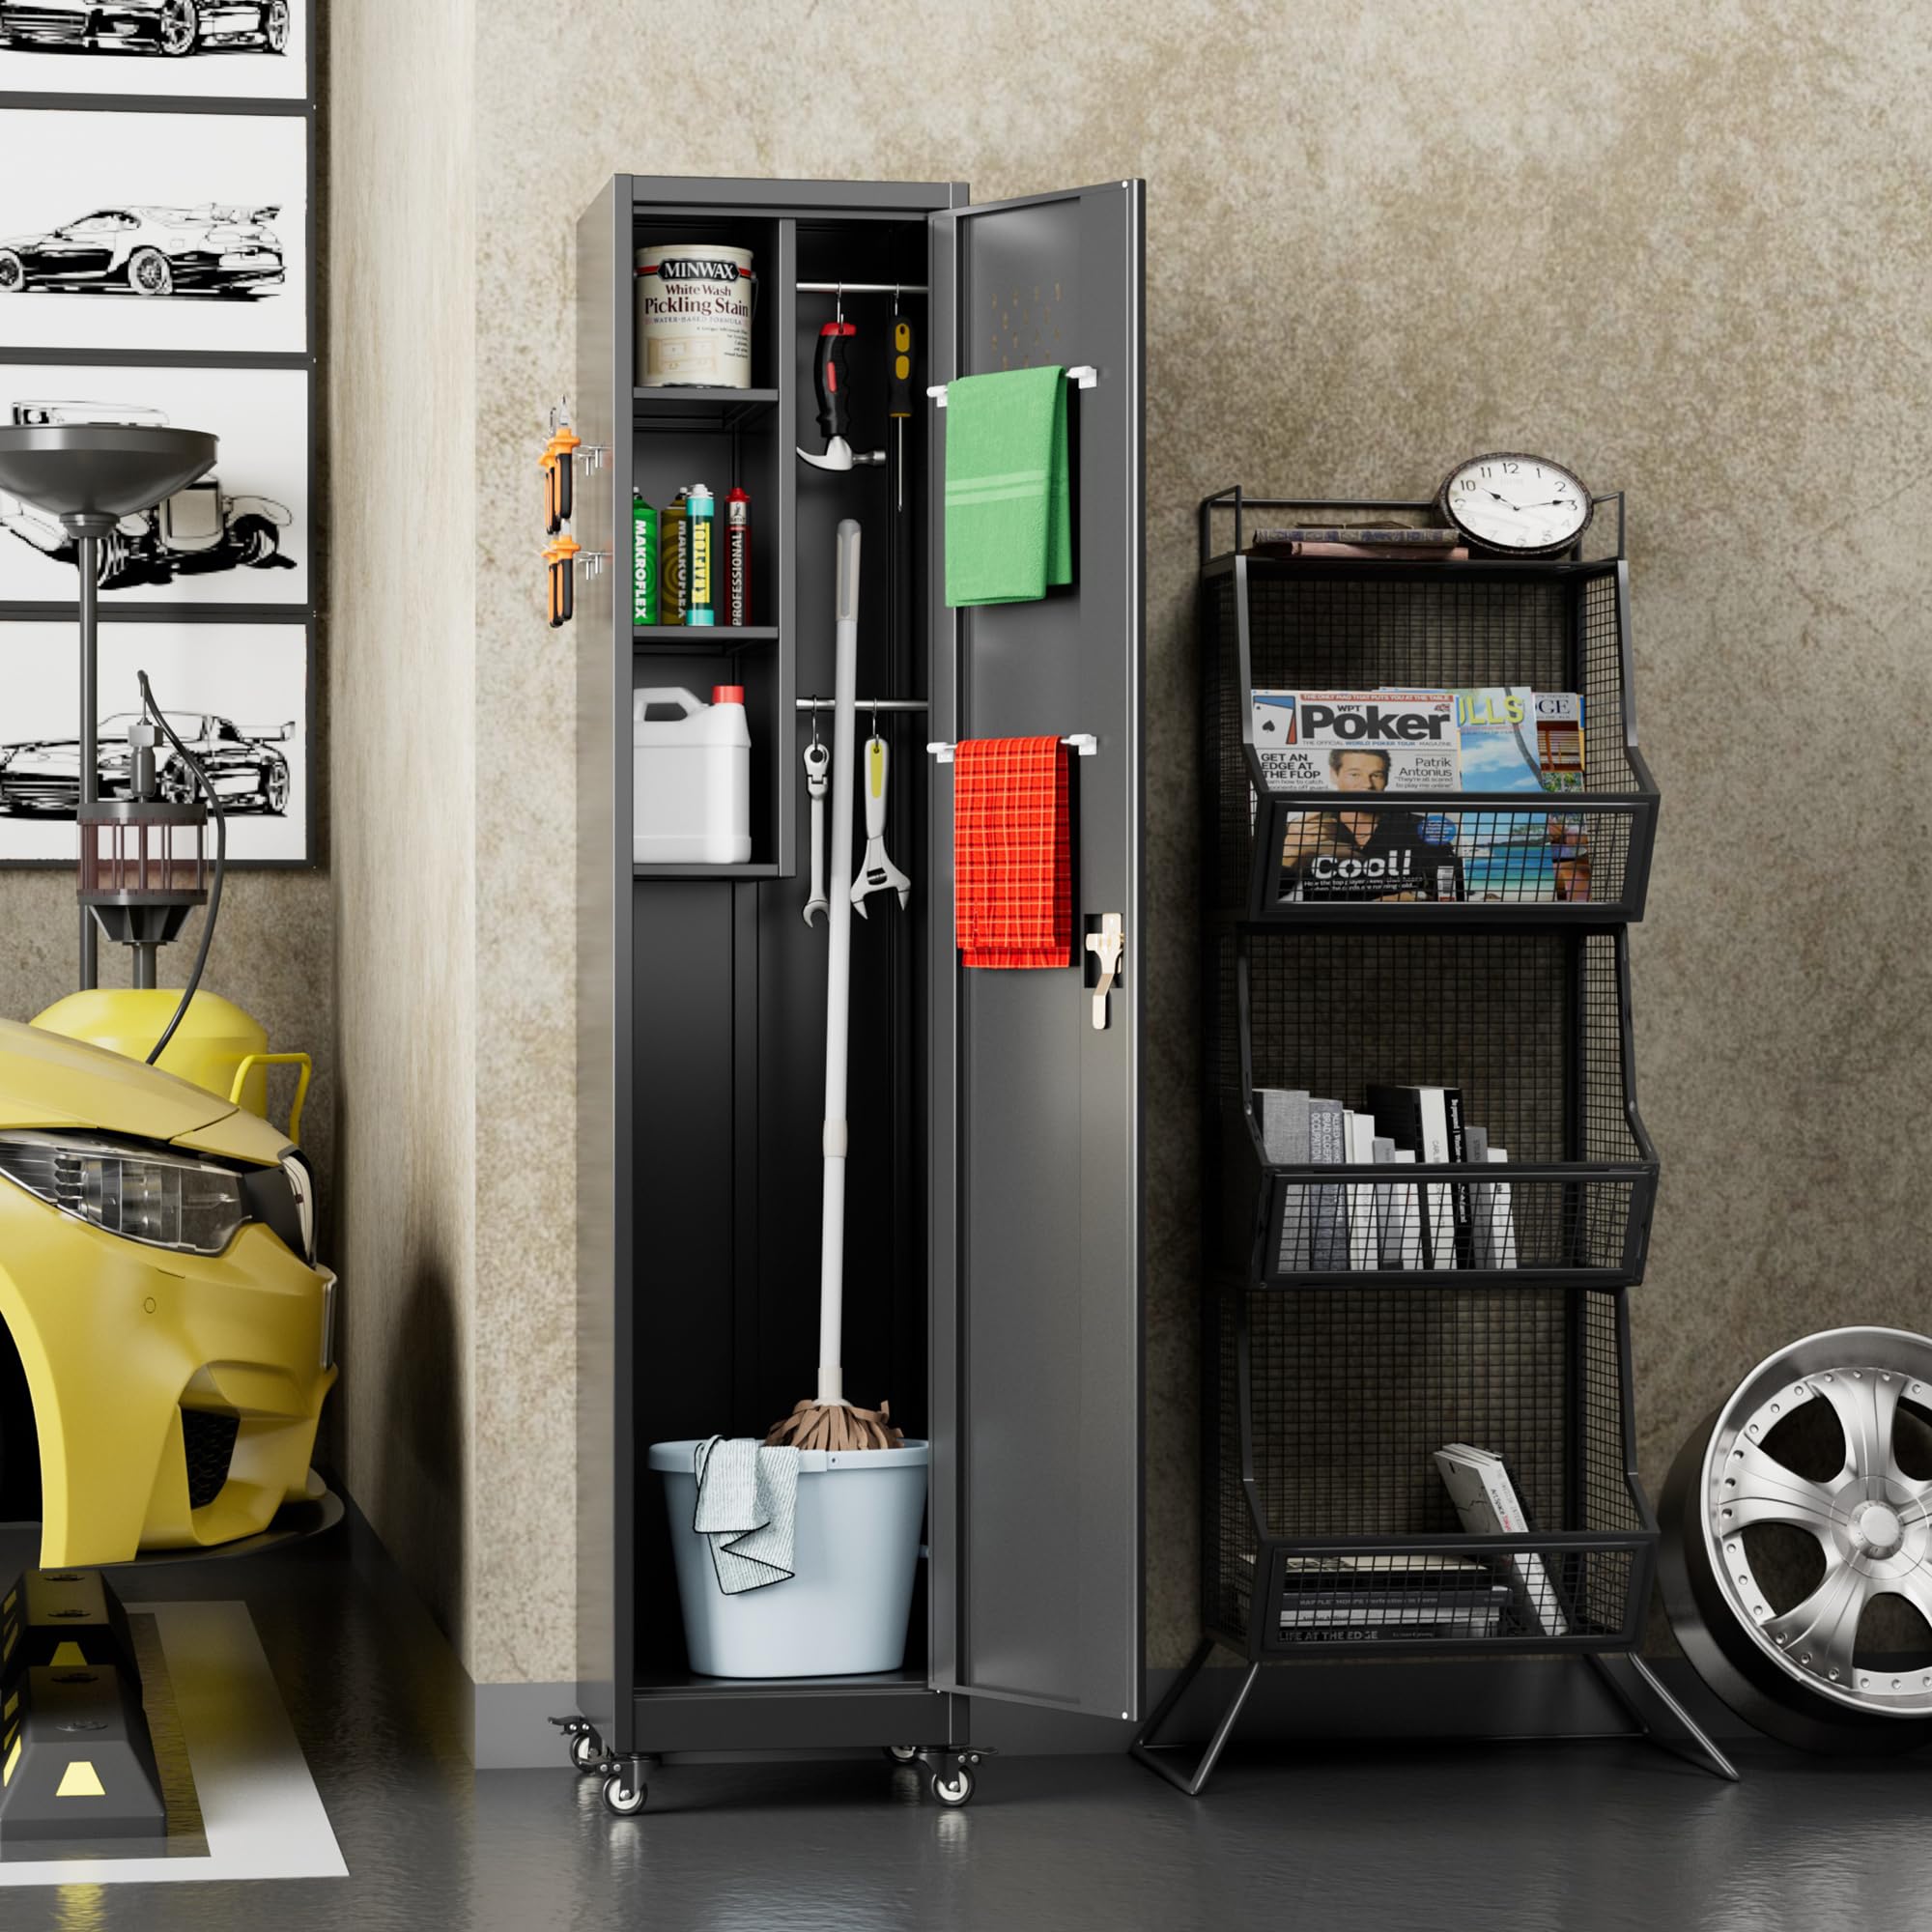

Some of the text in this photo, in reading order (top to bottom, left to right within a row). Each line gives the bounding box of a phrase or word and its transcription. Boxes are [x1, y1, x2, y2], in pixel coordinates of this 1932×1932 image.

[665, 262, 734, 279] MINWAX
[666, 284, 731, 297] White Wash
[645, 297, 749, 318] Pickling Stain
[1480, 467, 1492, 478] 11
[1503, 463, 1519, 473] 12
[1536, 468, 1541, 478] 1
[1461, 480, 1476, 491] 10
[1554, 481, 1566, 492] 2
[1567, 499, 1577, 511] 3
[635, 520, 646, 618] MAKROFLEX
[732, 532, 742, 626] PROFESSIONAL
[1301, 705, 1450, 740] Poker
[1415, 757, 1452, 767] Patrik
[1399, 767, 1453, 777] Antonius
[1311, 850, 1411, 879] Cool!
[1322, 1112, 1331, 1133] BRAD
[1312, 1112, 1322, 1160] OCCUPATION
[1280, 1632, 1303, 1640] LIFE
[1348, 1631, 1378, 1639] EDGE
